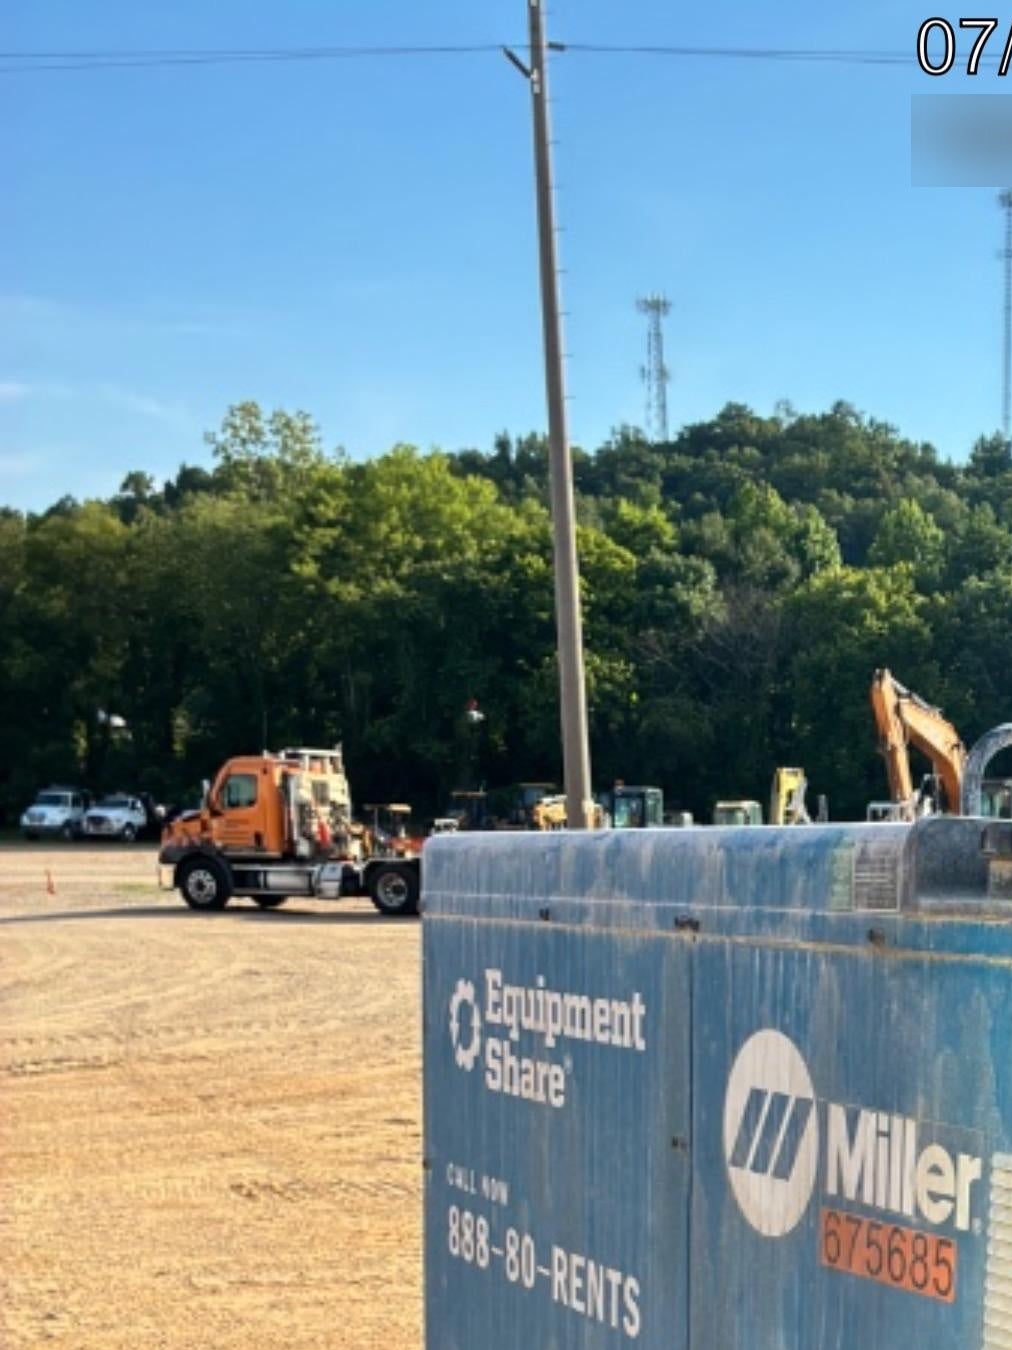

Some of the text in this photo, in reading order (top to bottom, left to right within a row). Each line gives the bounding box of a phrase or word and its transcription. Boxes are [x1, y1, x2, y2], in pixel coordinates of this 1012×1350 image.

[484, 968, 646, 1051] Equipment
[484, 1037, 566, 1109] Share
[826, 1103, 982, 1231] Miller
[447, 1205, 641, 1339] 888-80-RENTS
[823, 1211, 953, 1297] 675685
